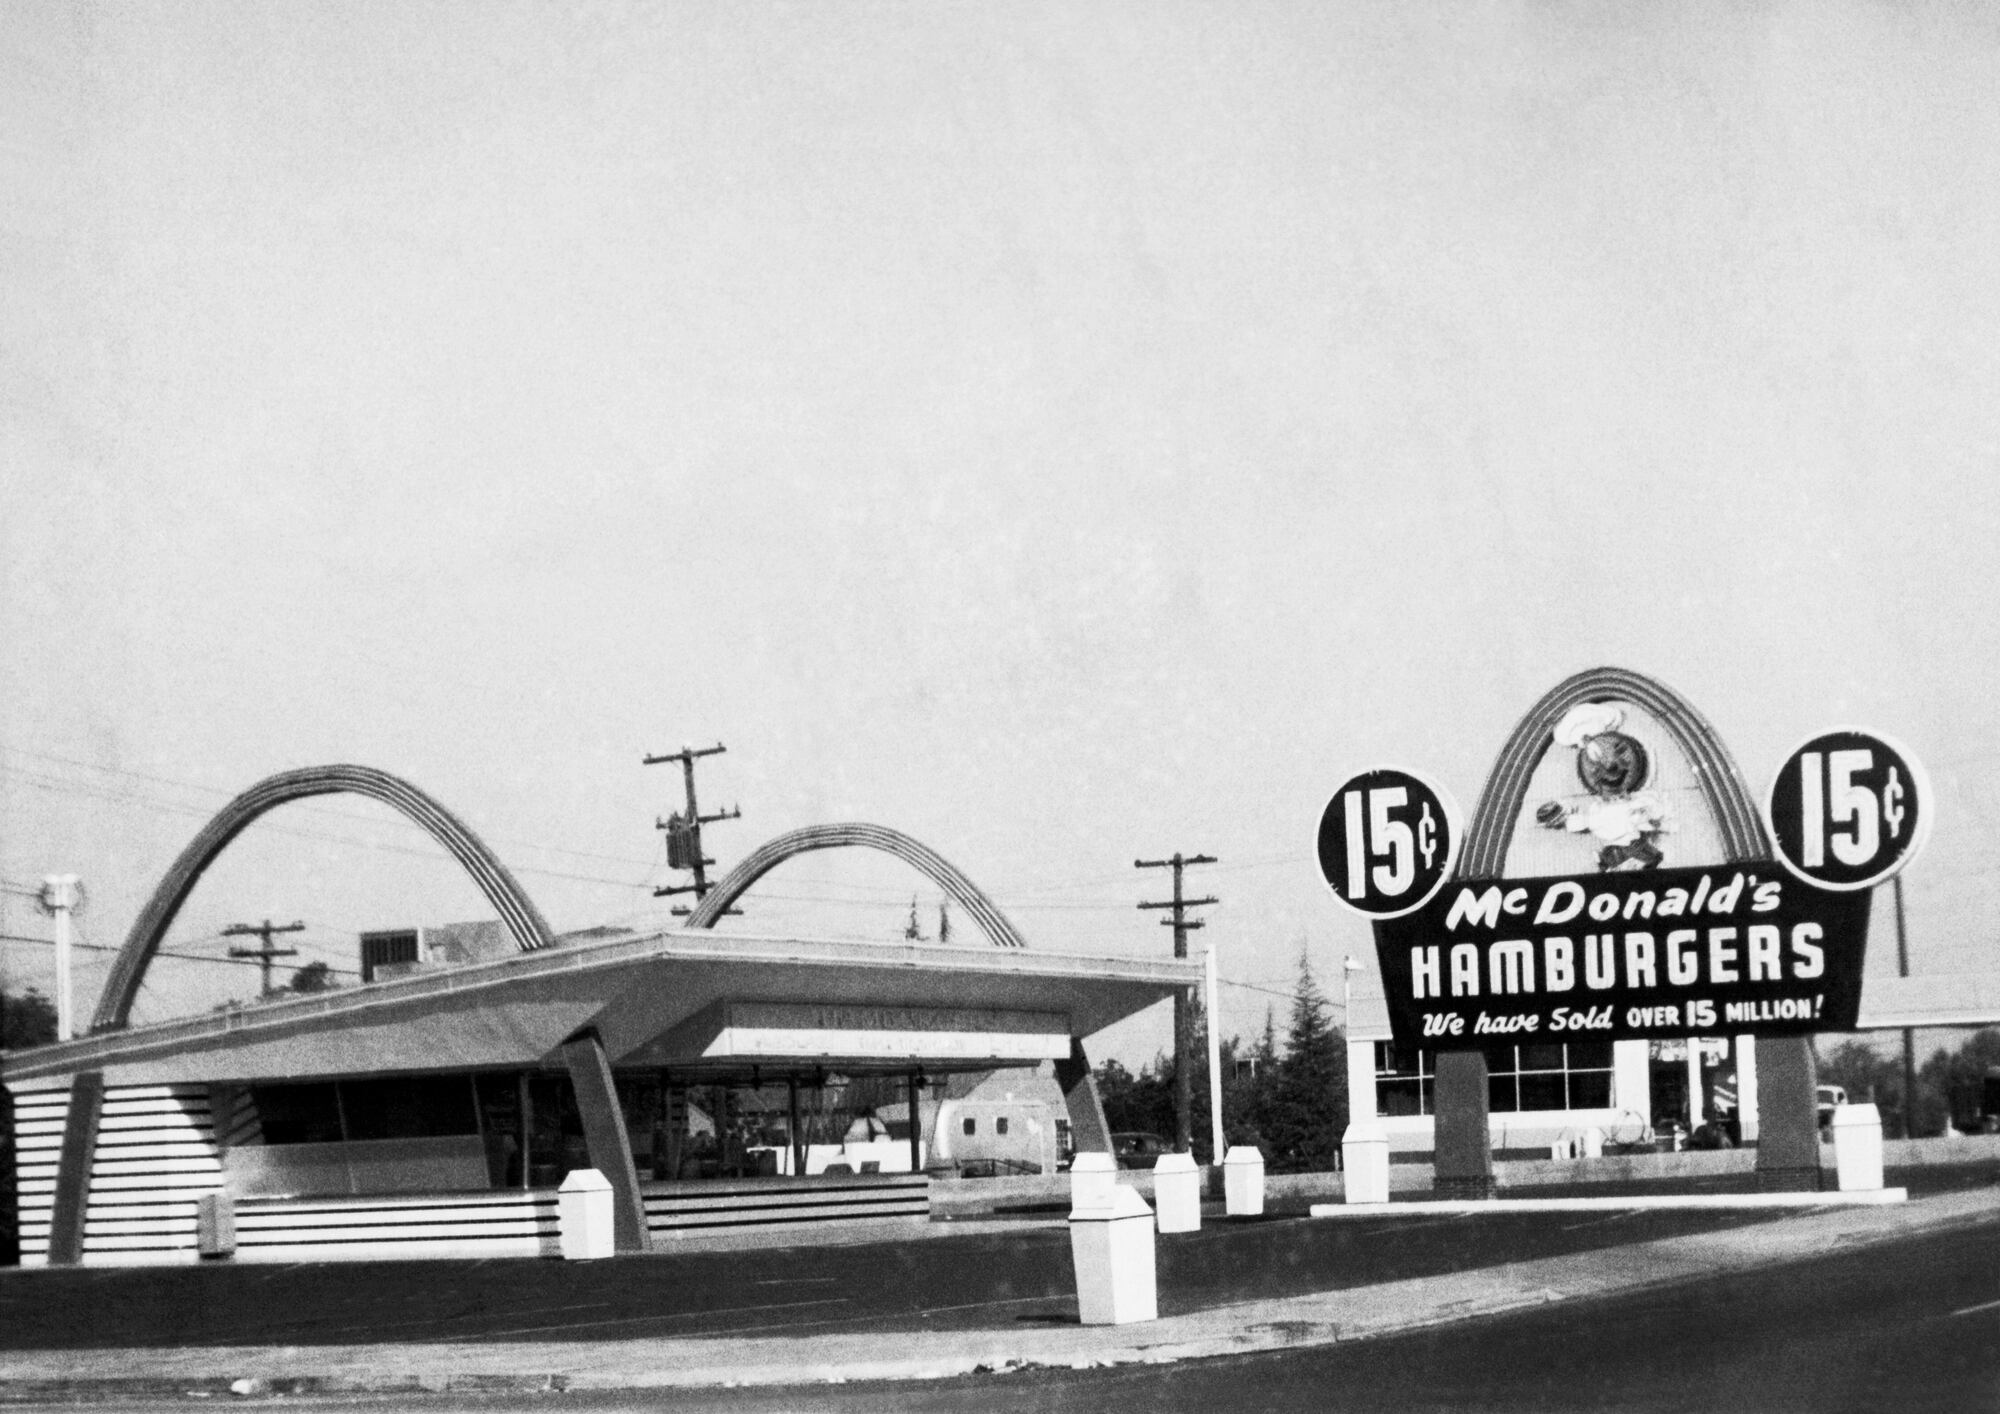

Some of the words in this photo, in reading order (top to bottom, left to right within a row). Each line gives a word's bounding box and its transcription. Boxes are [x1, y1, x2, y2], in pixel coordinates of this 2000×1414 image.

[1344, 787, 1436, 899] 15¢
[1801, 749, 1904, 867] 15¢
[1412, 923, 1824, 998] HAMBURGERS
[1423, 1013, 1465, 1036] We
[1474, 1012, 1539, 1034] have
[1549, 1005, 1613, 1031] Sold
[1626, 1006, 1680, 1029] OVER
[1686, 1000, 1718, 1027] 15
[1725, 995, 1824, 1023] MILLION!
